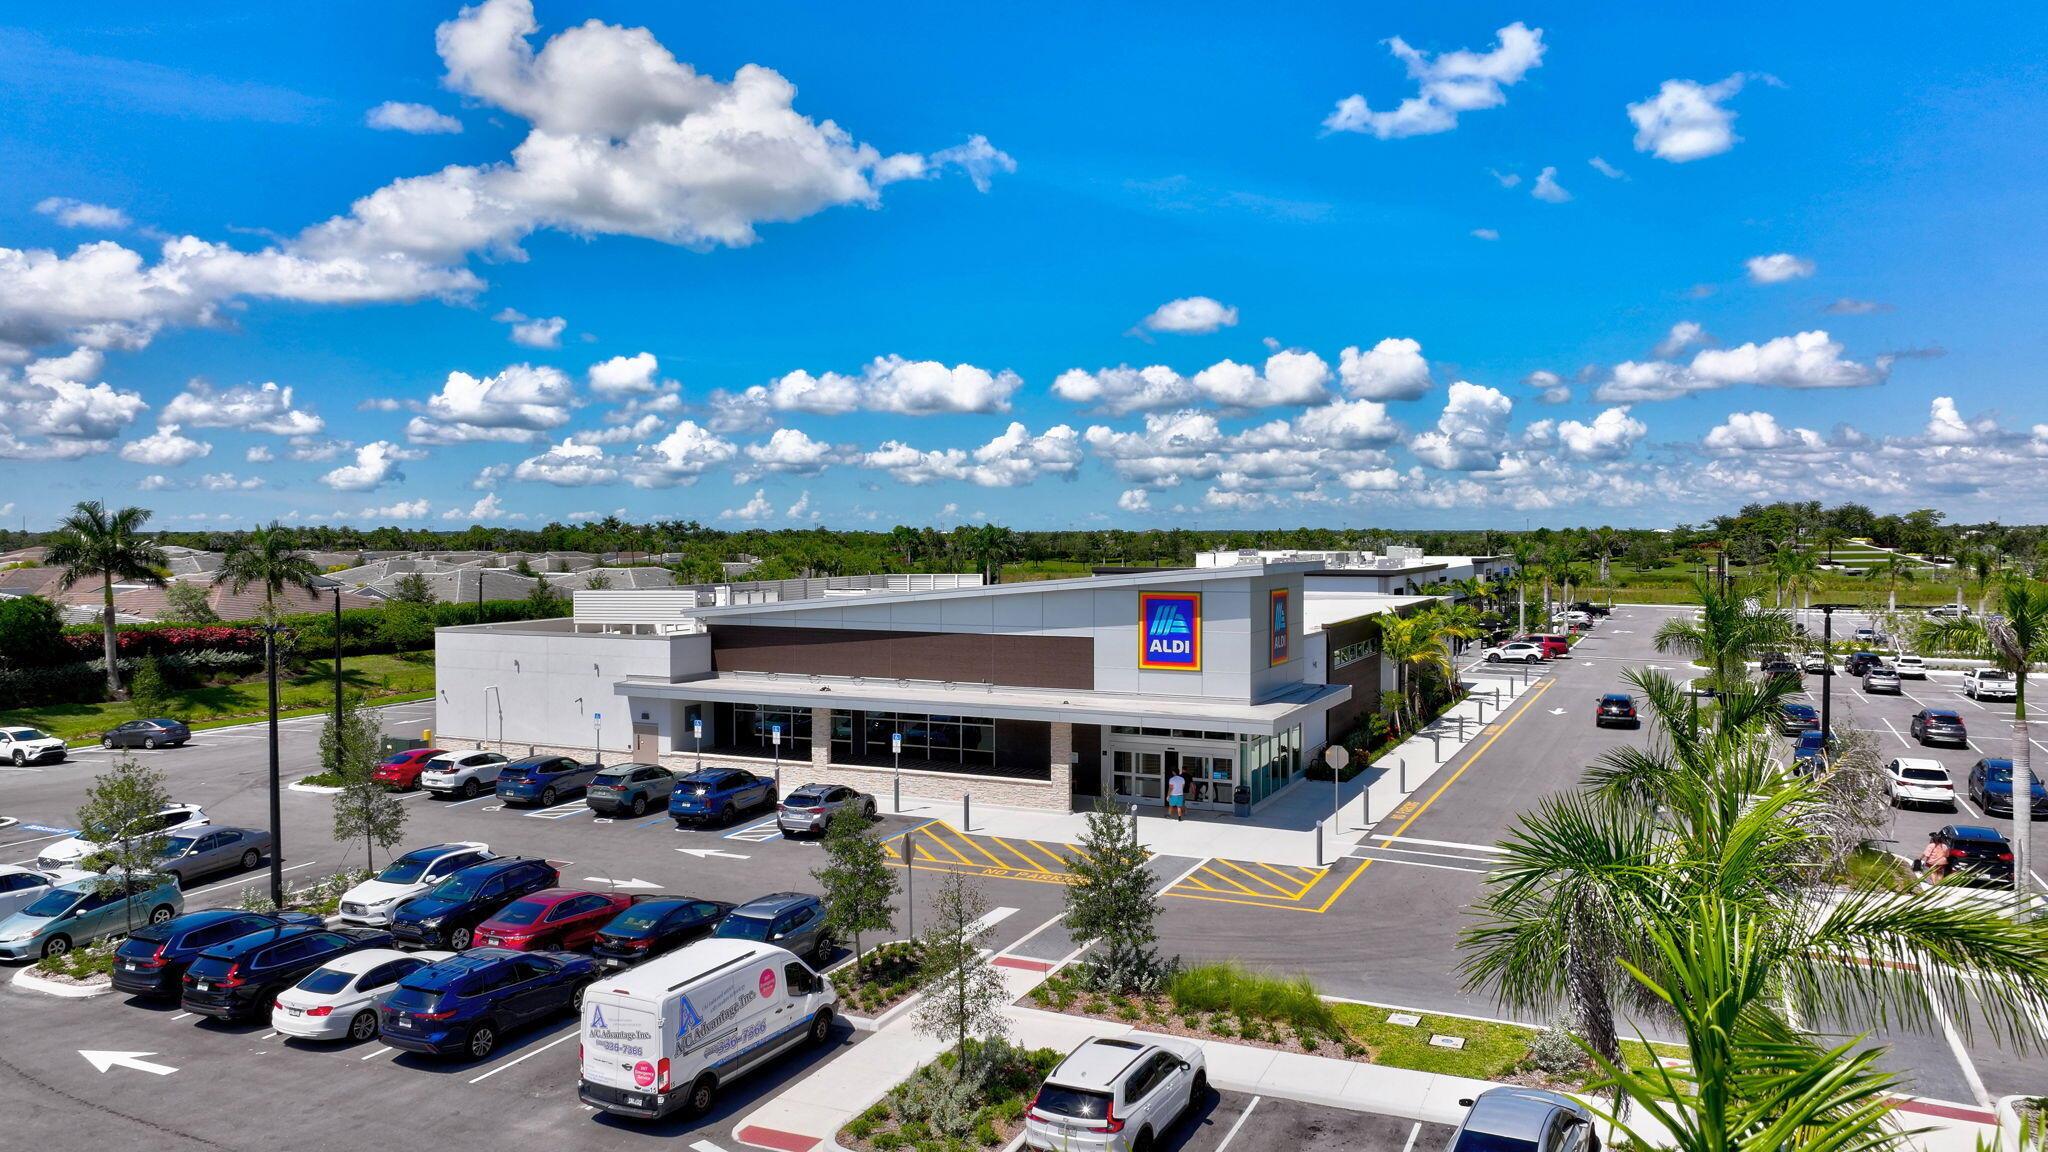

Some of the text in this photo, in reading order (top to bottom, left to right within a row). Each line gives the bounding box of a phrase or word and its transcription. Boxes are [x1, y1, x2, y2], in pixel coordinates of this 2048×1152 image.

[1149, 639, 1190, 654] ALDI
[1274, 634, 1287, 650] ALDI
[982, 867, 1008, 876] NO
[692, 1003, 740, 1042] Advantage
[601, 1030, 636, 1041] Advantage
